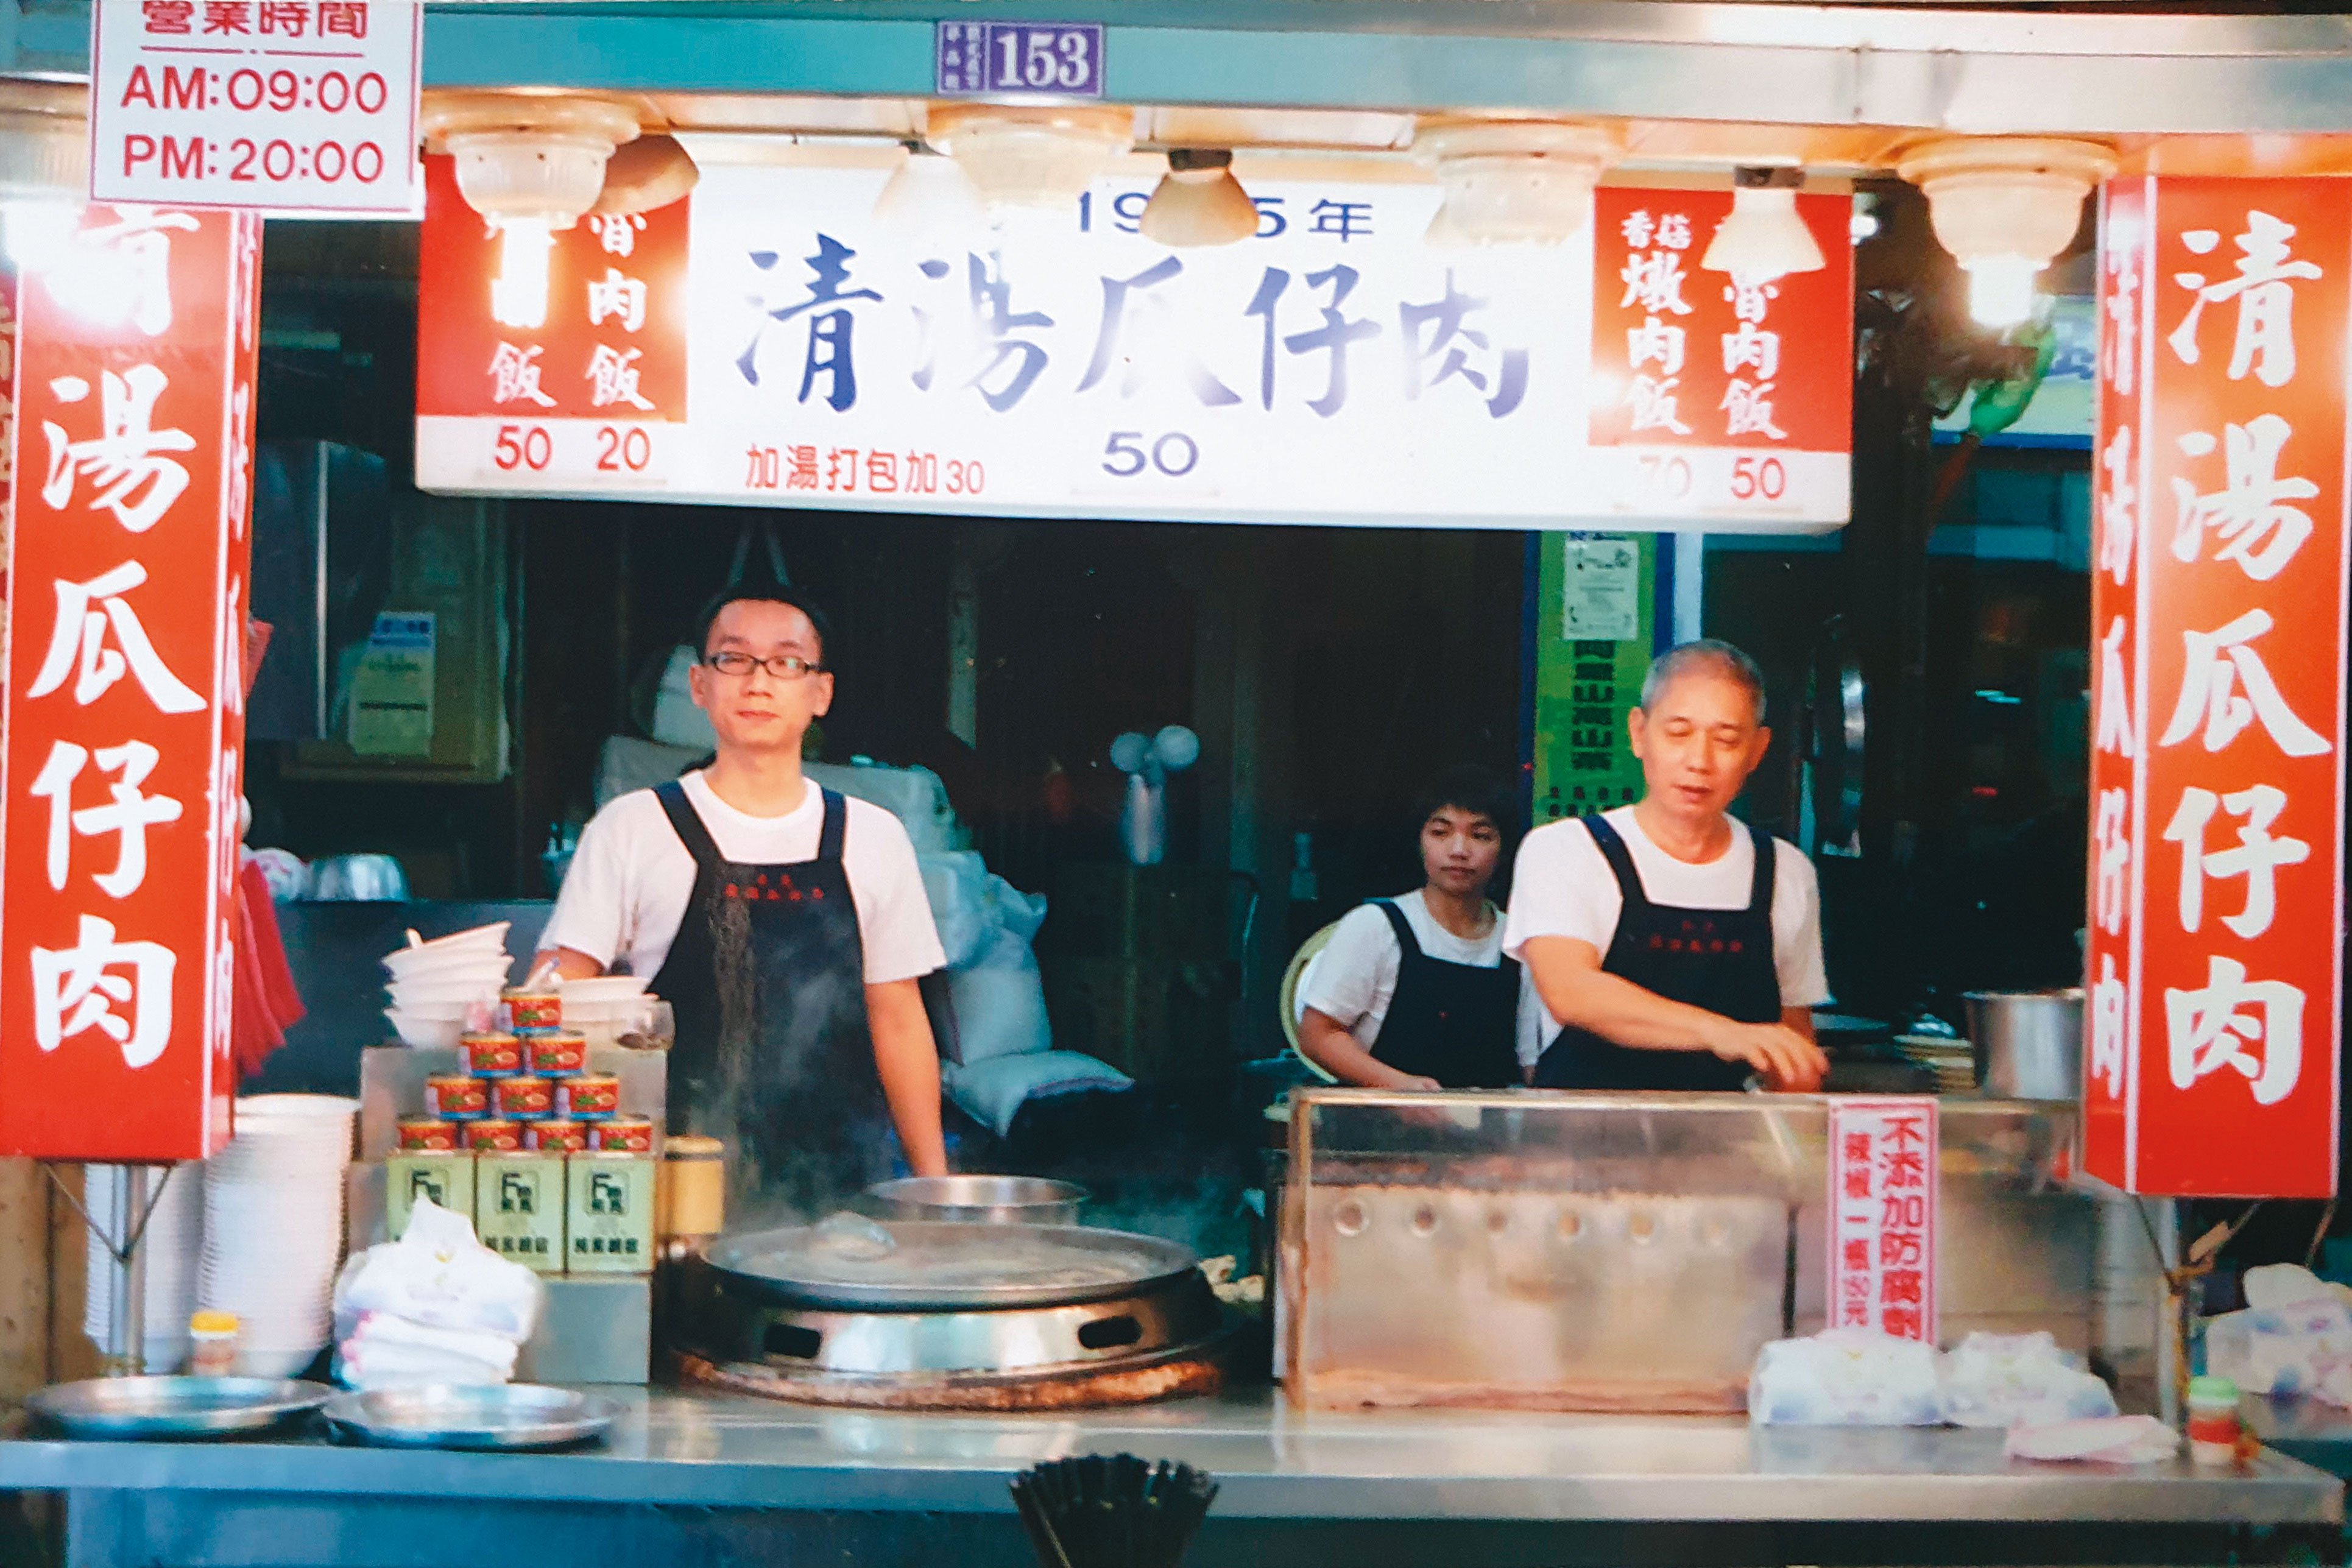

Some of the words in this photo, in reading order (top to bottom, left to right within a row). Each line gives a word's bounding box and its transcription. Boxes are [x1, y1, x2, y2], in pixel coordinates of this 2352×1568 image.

[997, 32, 1089, 87] 153
[121, 65, 388, 114] AM:09:00
[124, 134, 384, 183] PM:20:00
[1078, 190, 1374, 242] 195年
[1714, 213, 1787, 440] 魯肉飯
[495, 426, 553, 470] 50
[596, 427, 651, 471] 20
[746, 443, 984, 495] 加湯打包加30
[1102, 431, 1199, 477] 50
[1731, 457, 1786, 500] 50
[2159, 210, 2333, 1105] 清湯瓜仔肉
